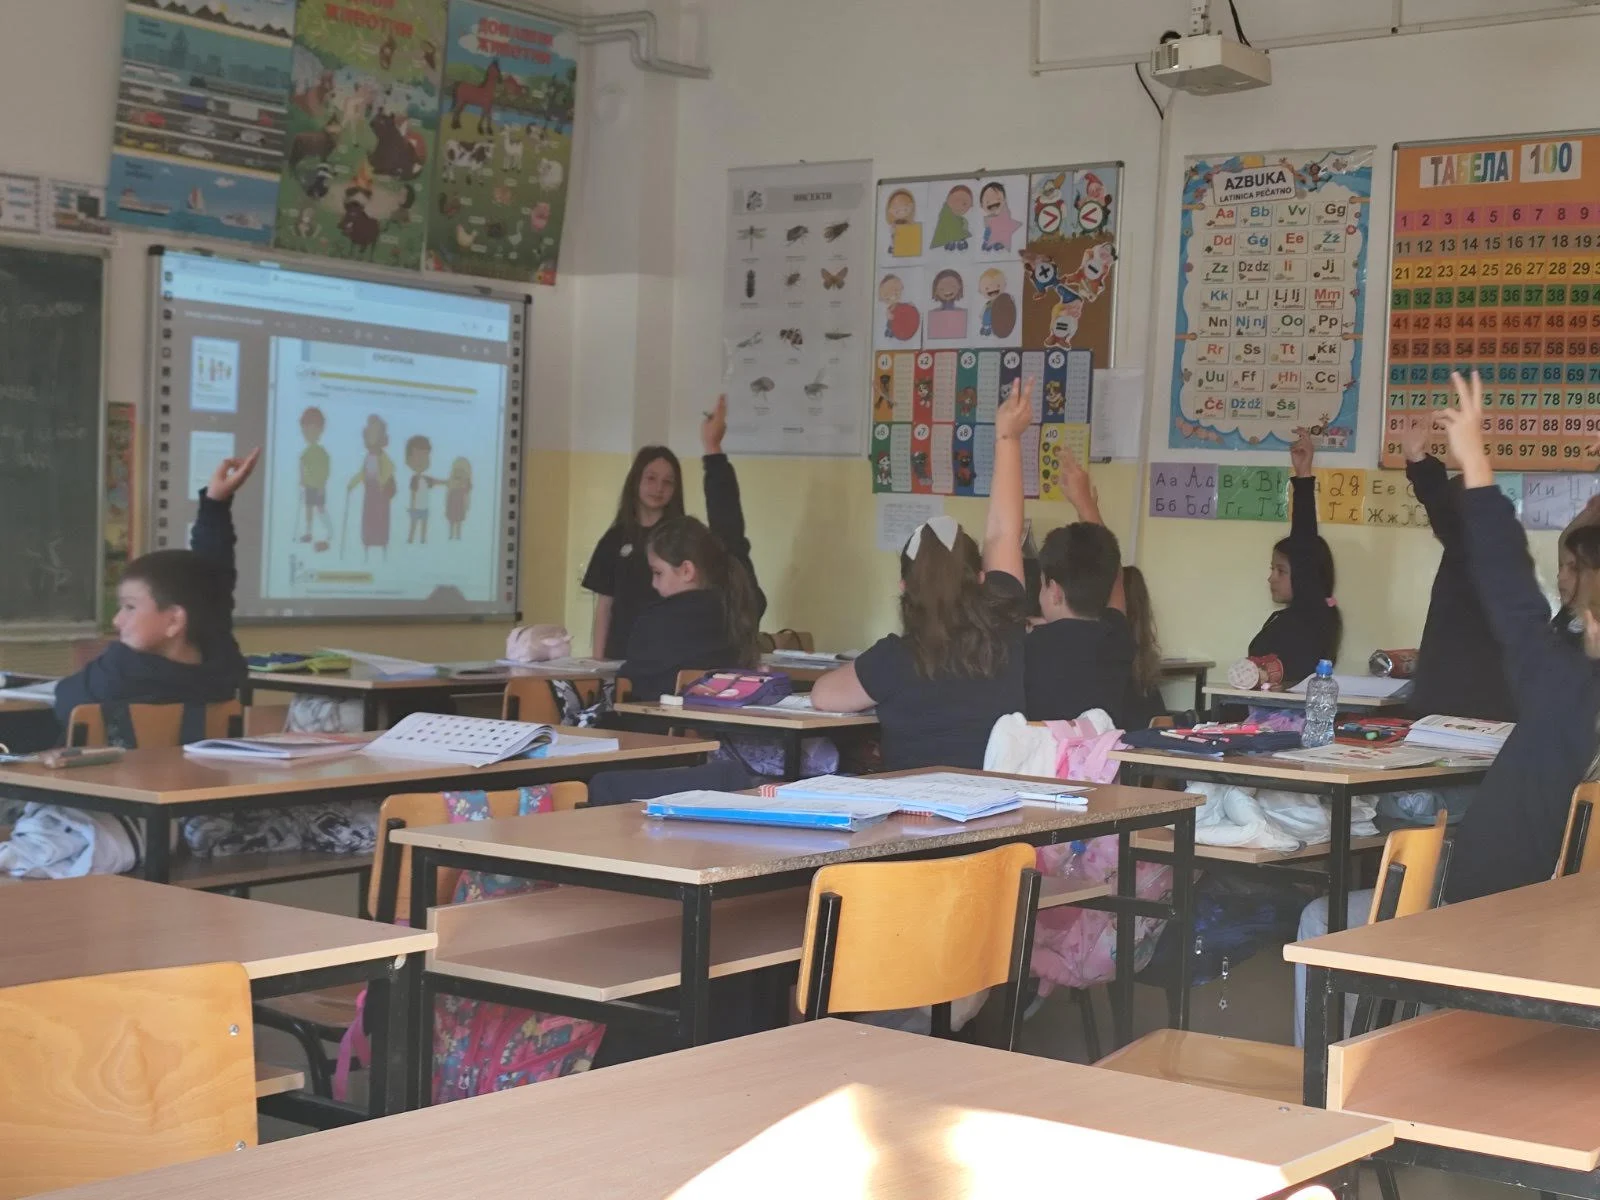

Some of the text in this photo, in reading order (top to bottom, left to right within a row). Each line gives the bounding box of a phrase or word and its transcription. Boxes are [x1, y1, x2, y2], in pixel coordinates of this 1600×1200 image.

[1430, 143, 1572, 185] ТАБЕЛА 100
[1224, 171, 1286, 190] AZBUKA
[1220, 187, 1291, 202] LATINICA PEČATNO
[1216, 204, 1346, 218] Aa Bb Vv Gg
[1402, 207, 1588, 226] 1 2 3 4 5 6 7 8 9
[1214, 235, 1232, 245] Dd
[1286, 233, 1304, 243] Ee
[1397, 235, 1591, 253] 11 12 13 14 15 16 17 18 19
[1395, 263, 1590, 279] 21 22 23 24 25 26 27 28 29
[1211, 291, 1228, 300] Kk
[1247, 291, 1259, 300] Ll
[1315, 289, 1340, 299] Mm
[1394, 290, 1589, 305] 31 32 33 34 35 36 37 38 39
[1209, 317, 1227, 327] Nn
[1282, 315, 1302, 326] Oo
[1319, 315, 1338, 328] Pp
[1393, 319, 1408, 329] 41
[1414, 318, 1429, 328] 42
[1435, 317, 1450, 328] 43
[1457, 316, 1473, 327] 44
[1480, 316, 1496, 327] 45
[1503, 316, 1520, 327] 46
[1524, 316, 1540, 327] 47
[1547, 316, 1564, 327] 48
[1569, 316, 1586, 327] 49
[1208, 344, 1223, 354] Rr
[1244, 344, 1261, 354] Ss
[1280, 344, 1294, 354] Tt
[1393, 344, 1408, 355] 51
[1413, 344, 1428, 355] 52
[1434, 344, 1449, 355] 53
[1457, 344, 1473, 355] 54
[1479, 343, 1495, 354] 55
[1503, 343, 1518, 354] 56
[1524, 343, 1540, 354] 57
[1547, 343, 1563, 354] 58
[1569, 343, 1586, 355] 59
[1206, 371, 1335, 383] Uu Ff Hh Cc
[1391, 369, 1405, 380] 61
[1411, 369, 1426, 380] 62
[1433, 369, 1448, 380] 63
[1500, 368, 1516, 379] 66
[1521, 368, 1538, 380] 67
[1544, 368, 1560, 380] 68
[1567, 369, 1584, 381] 69
[1391, 394, 1404, 405] 71
[1411, 394, 1426, 405] 72
[1433, 394, 1448, 405] 73
[1500, 394, 1514, 405] 76
[1521, 394, 1537, 405] 77
[1544, 394, 1560, 405] 78
[1567, 393, 1582, 404] 79
[1391, 419, 1404, 430] 81
[1498, 419, 1513, 430] 86
[1520, 419, 1536, 431] 87
[1543, 419, 1558, 431] 88
[1565, 419, 1581, 430] 89
[1388, 444, 1402, 454] 91
[1431, 444, 1446, 454] 93
[1497, 444, 1513, 455] 96
[1520, 445, 1535, 456] 97
[1542, 445, 1557, 456] 98
[1564, 446, 1580, 457] 99
